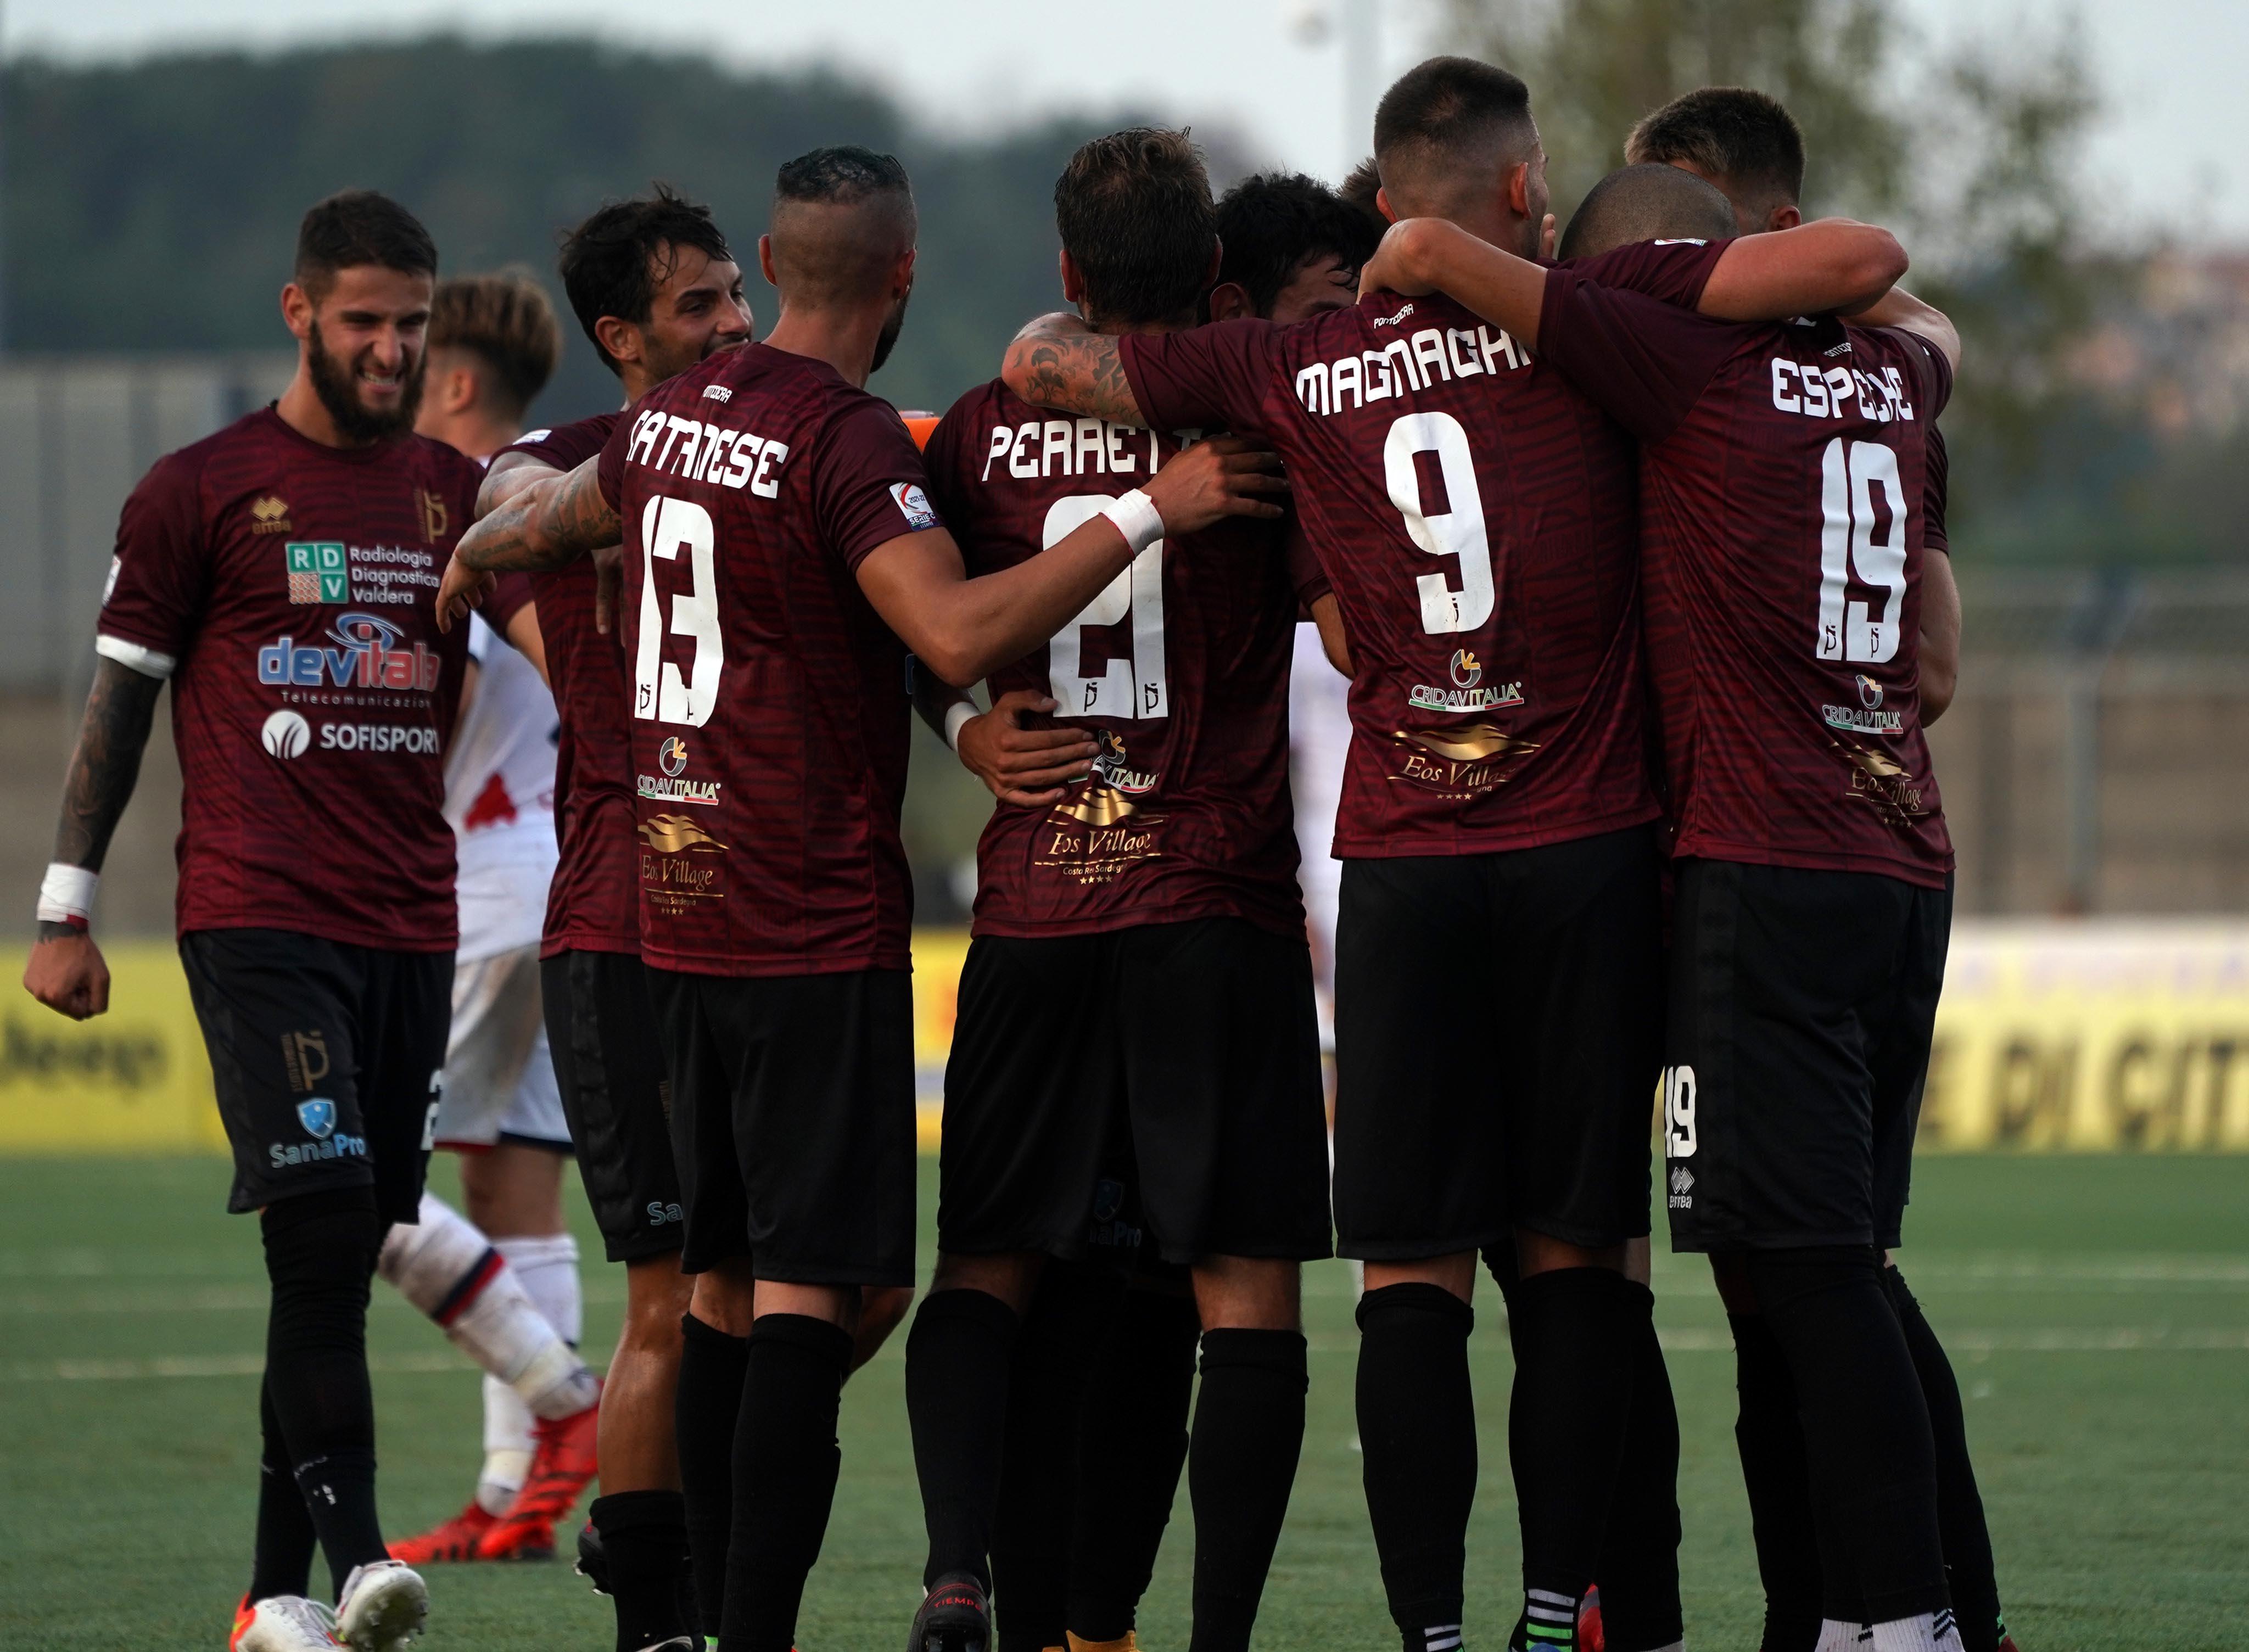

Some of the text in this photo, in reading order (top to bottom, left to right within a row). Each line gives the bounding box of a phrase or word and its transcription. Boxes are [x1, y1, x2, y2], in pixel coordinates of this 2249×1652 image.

[1374, 304, 1413, 329] PONTEDERA
[1296, 325, 1531, 416] MAGNAGHI
[909, 513, 930, 524] SERIE
[1383, 412, 1495, 634] 9
[294, 548, 339, 568] R D
[350, 545, 433, 568] Radiologia
[1816, 437, 1907, 663] 19
[325, 579, 342, 597] V
[351, 567, 439, 588] Diagnostica
[352, 586, 415, 604] Valdera
[1043, 494, 1168, 720] 21
[634, 495, 724, 728] 13
[1401, 755, 1442, 782] Eos
[1089, 829, 1151, 854] Village
[662, 858, 713, 892] Village
[1665, 1065, 1697, 1158] 19
[269, 1134, 366, 1168] SanaPro
[1669, 1195, 1692, 1209] errea
